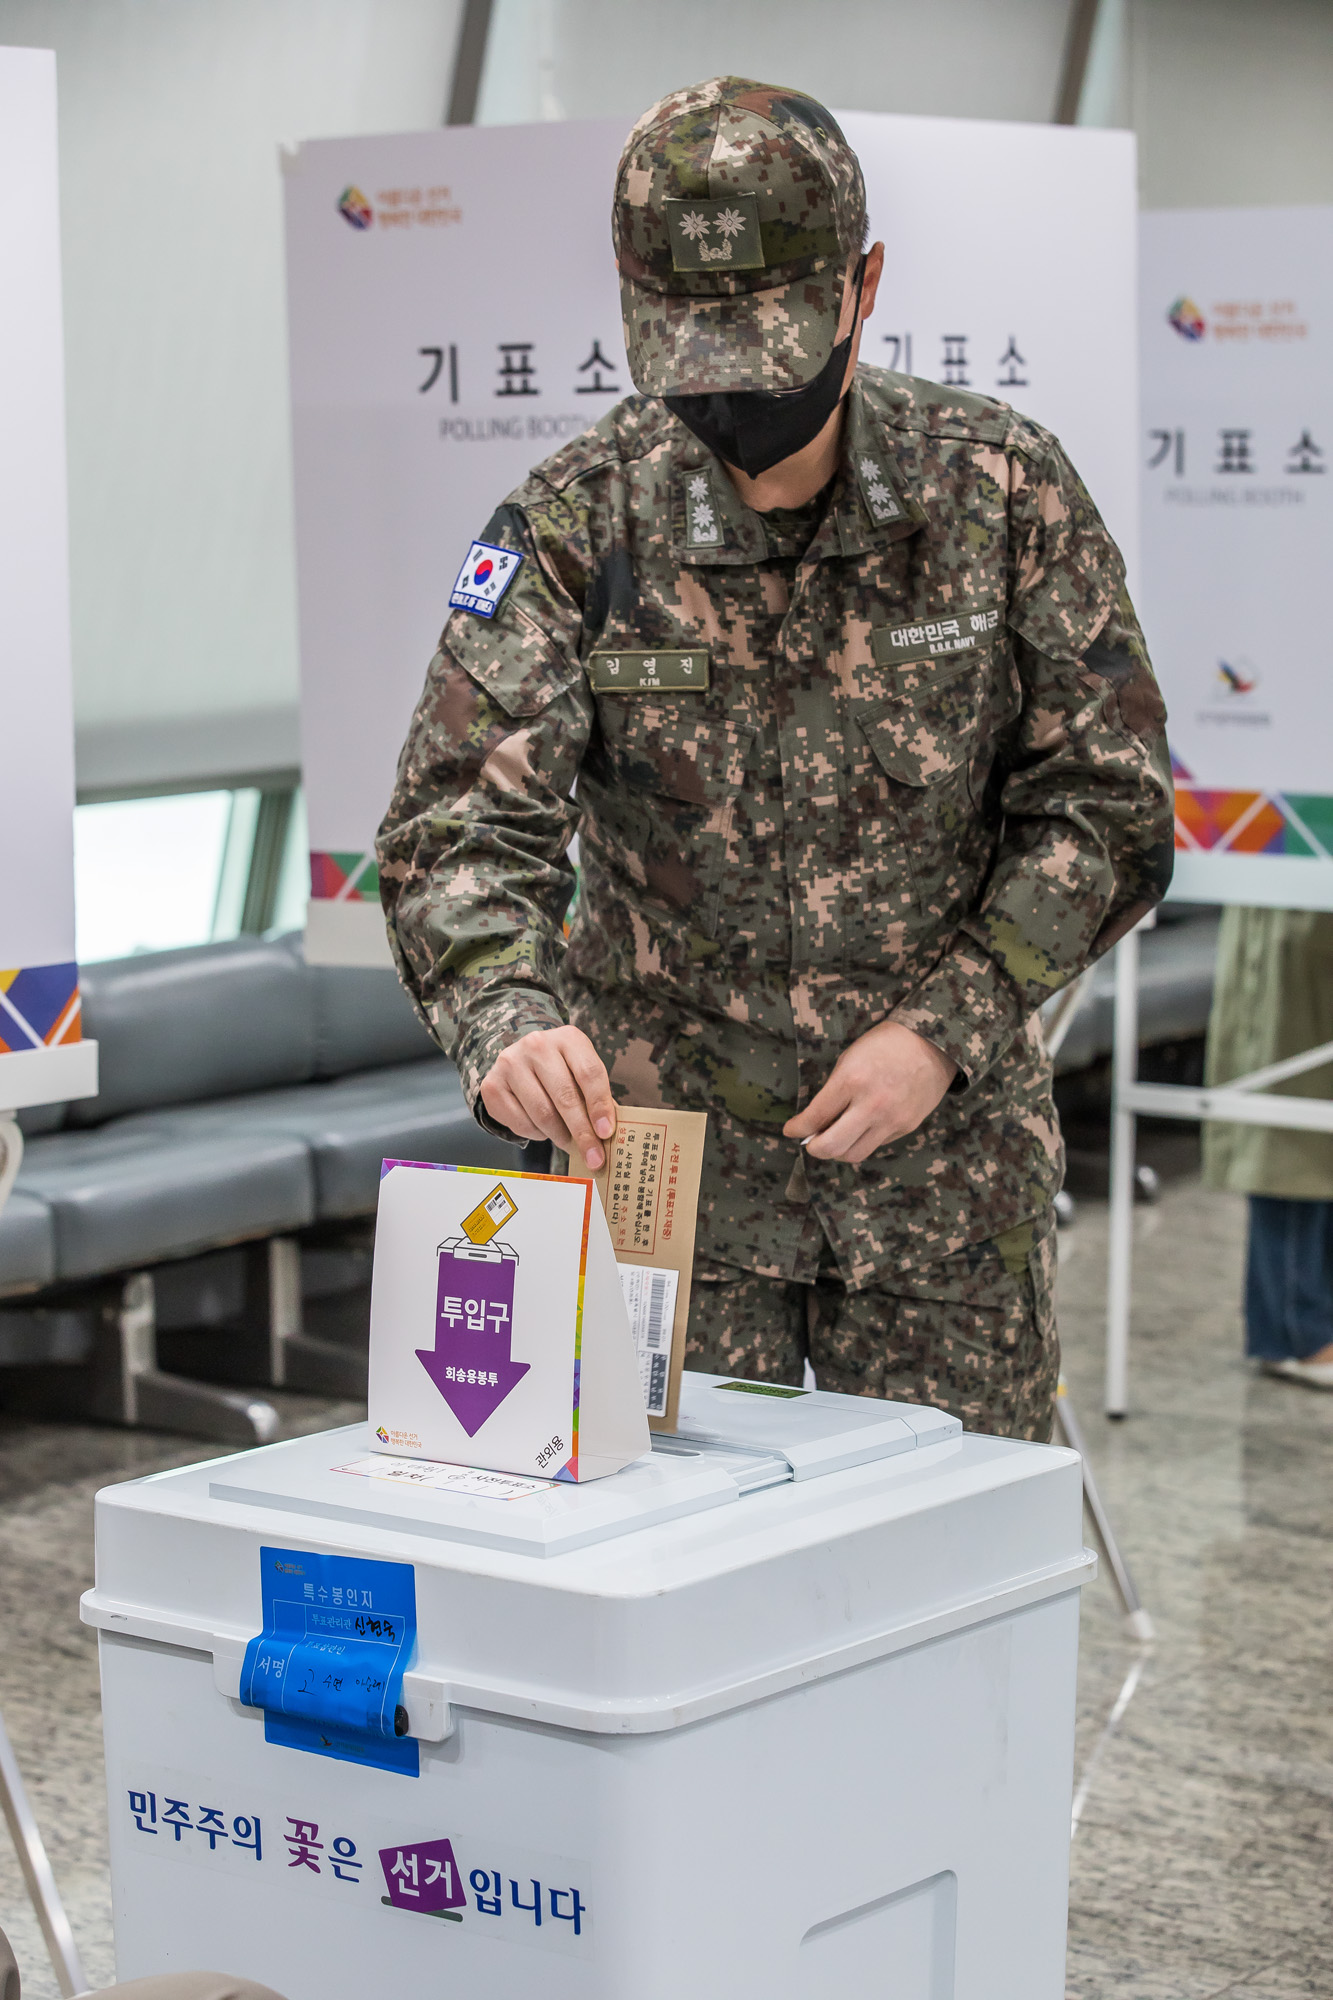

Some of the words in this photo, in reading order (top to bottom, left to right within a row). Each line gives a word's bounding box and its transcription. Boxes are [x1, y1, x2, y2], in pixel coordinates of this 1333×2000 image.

[890, 619, 961, 647] 대한민국
[969, 610, 999, 632] 해군
[639, 678, 660, 686] KIM
[614, 1160, 623, 1179] 적지
[623, 1151, 633, 1179] 사무실
[668, 1143, 681, 1185] 사전투표
[440, 1296, 510, 1334] 투입구
[445, 1366, 499, 1387] 회송용봉투
[404, 1440, 422, 1448] 대한민국
[535, 1435, 564, 1469] 관외용
[303, 1582, 373, 1609] 특수봉인지
[311, 1613, 352, 1631] 투표관리관
[257, 1655, 285, 1679] 서명
[127, 1790, 263, 1862] 민주주의
[283, 1816, 364, 1884] 꽃은
